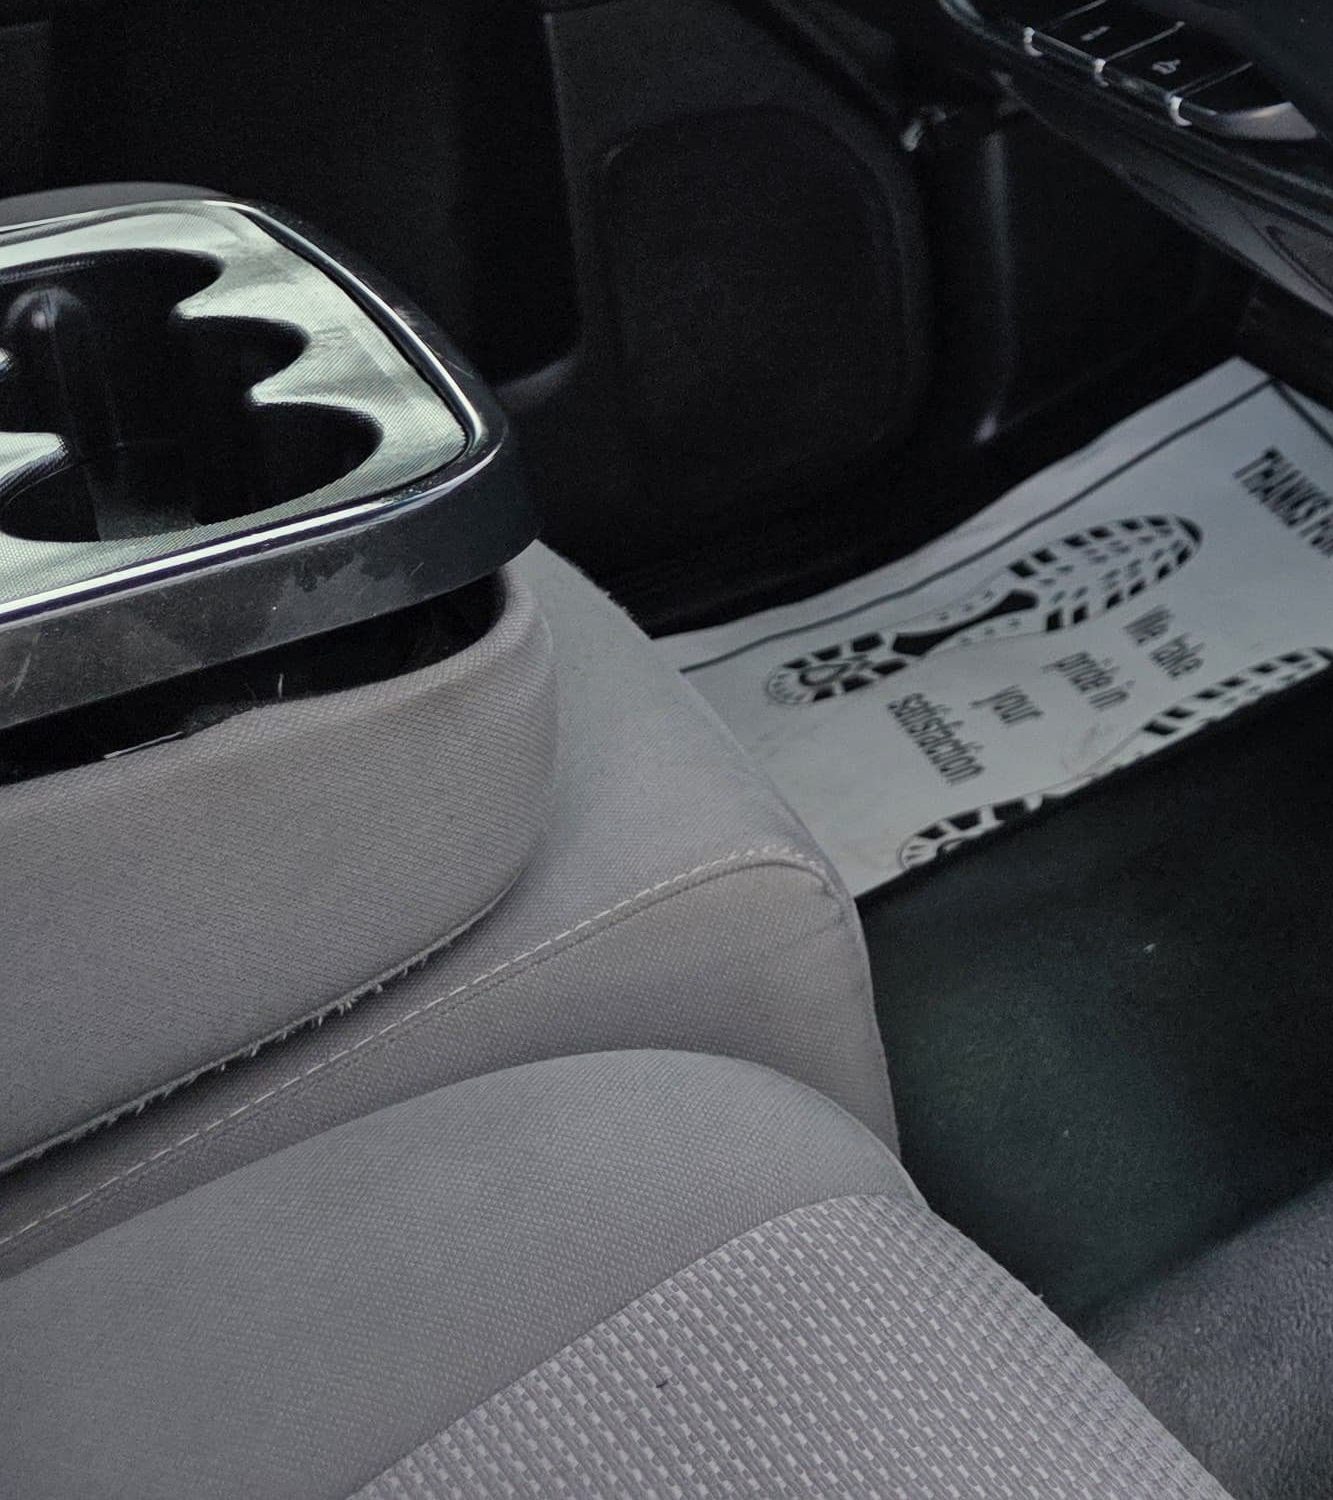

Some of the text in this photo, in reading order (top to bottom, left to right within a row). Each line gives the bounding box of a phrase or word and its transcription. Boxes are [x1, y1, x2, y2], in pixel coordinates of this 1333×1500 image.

[1232, 445, 1333, 529] THANKS
[1123, 604, 1206, 680] We take
[969, 684, 1045, 725] your
[1042, 651, 1135, 712] pride in
[886, 692, 985, 786] satisfaction
